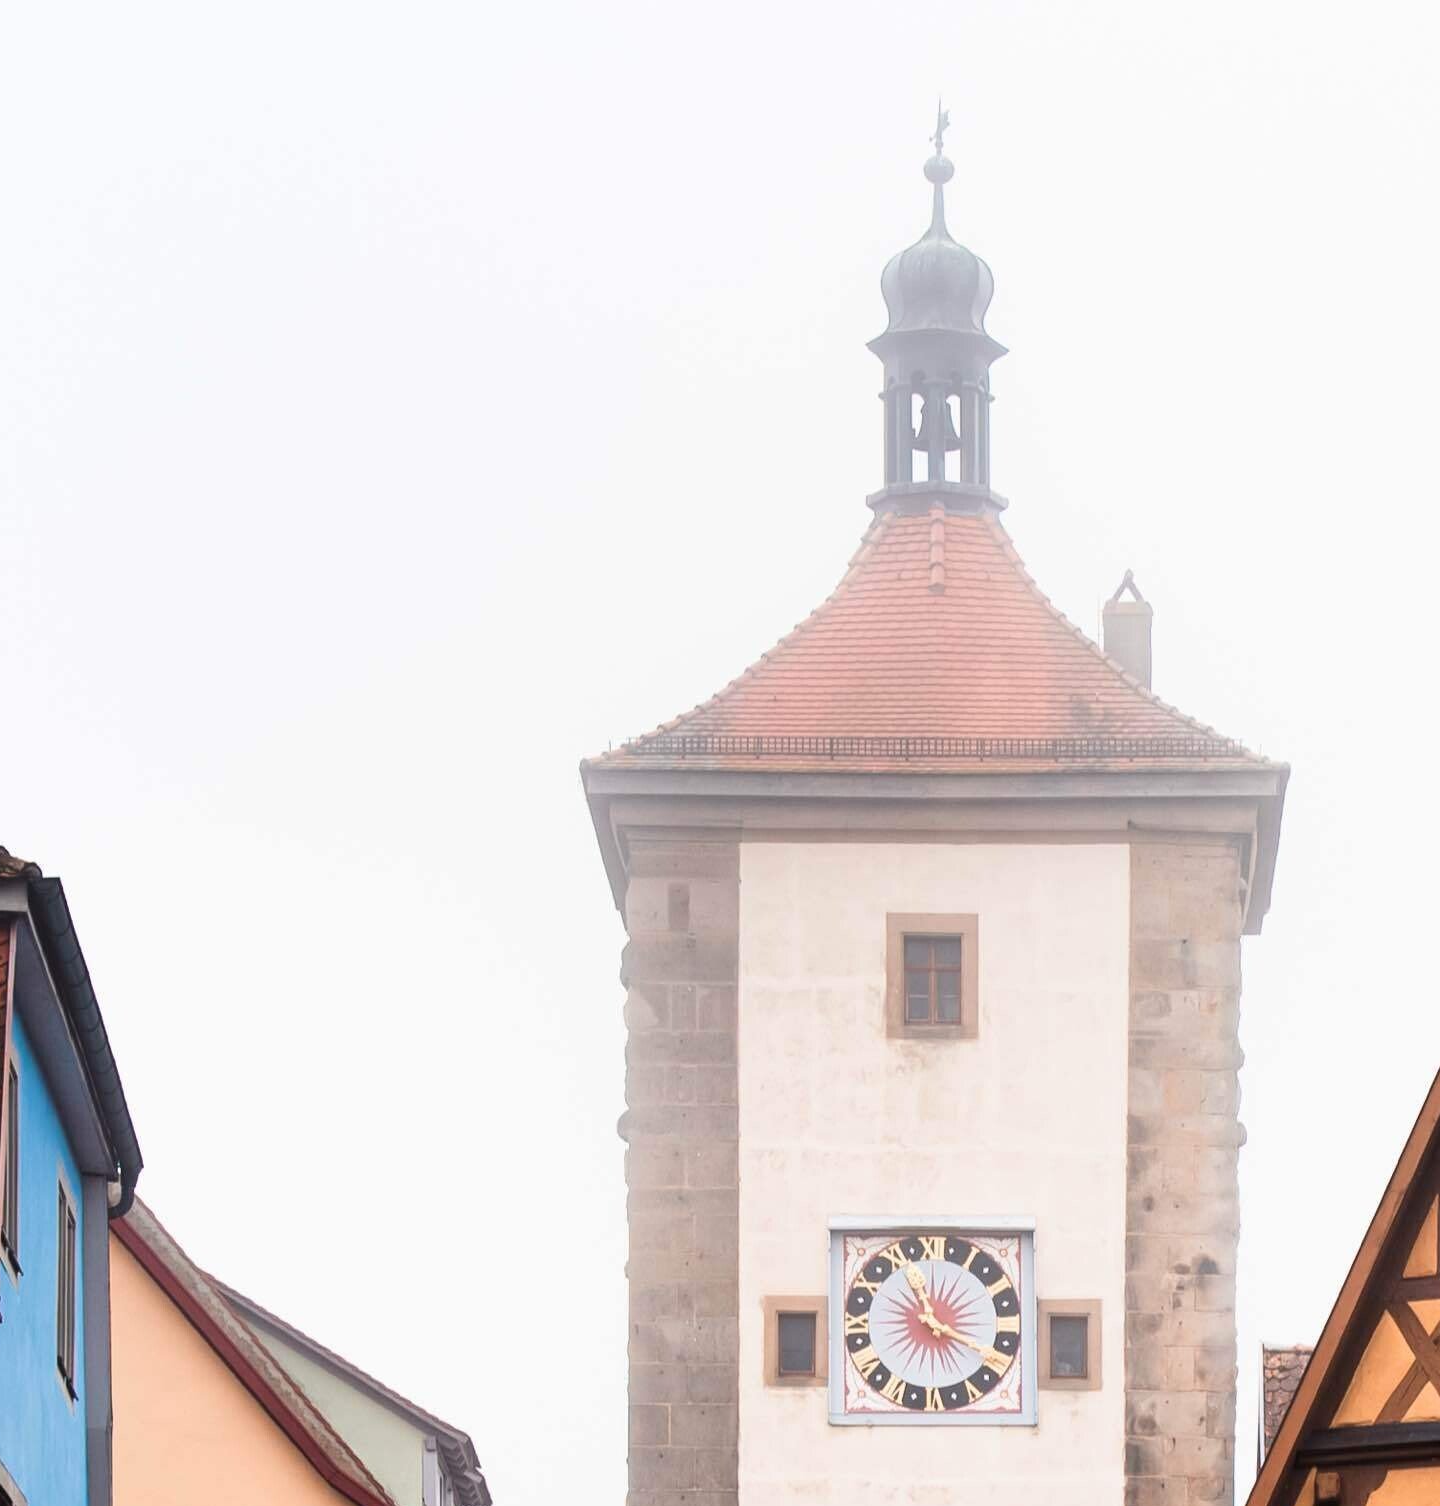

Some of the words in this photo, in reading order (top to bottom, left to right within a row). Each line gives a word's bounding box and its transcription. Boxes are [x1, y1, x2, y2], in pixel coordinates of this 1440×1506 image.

[879, 1242, 908, 1267] XI
[918, 1236, 947, 1261] XII
[854, 1275, 882, 1296] X
[923, 1386, 946, 1412] VI
[964, 1380, 984, 1402] V
